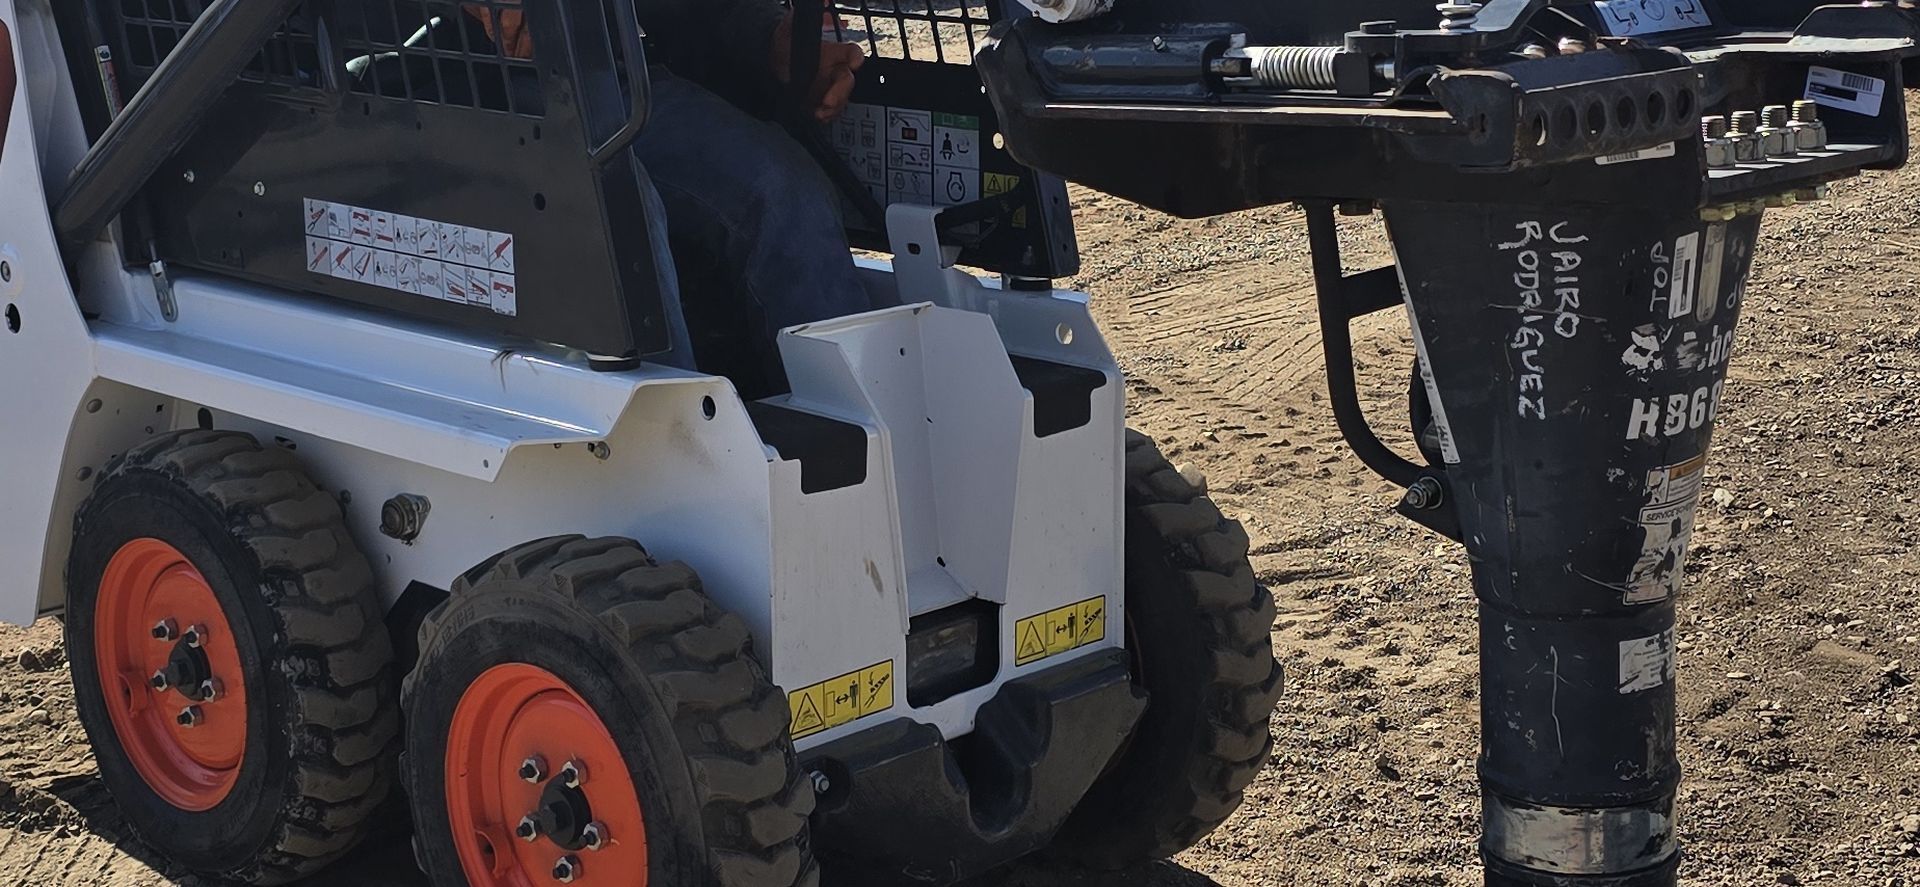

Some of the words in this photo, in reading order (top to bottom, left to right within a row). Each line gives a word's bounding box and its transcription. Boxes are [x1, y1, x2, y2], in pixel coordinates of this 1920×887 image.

[1498, 220, 1546, 420] RODRIGUEZ
[1549, 220, 1589, 338] JAIRO
[1649, 241, 1669, 312] TOP
